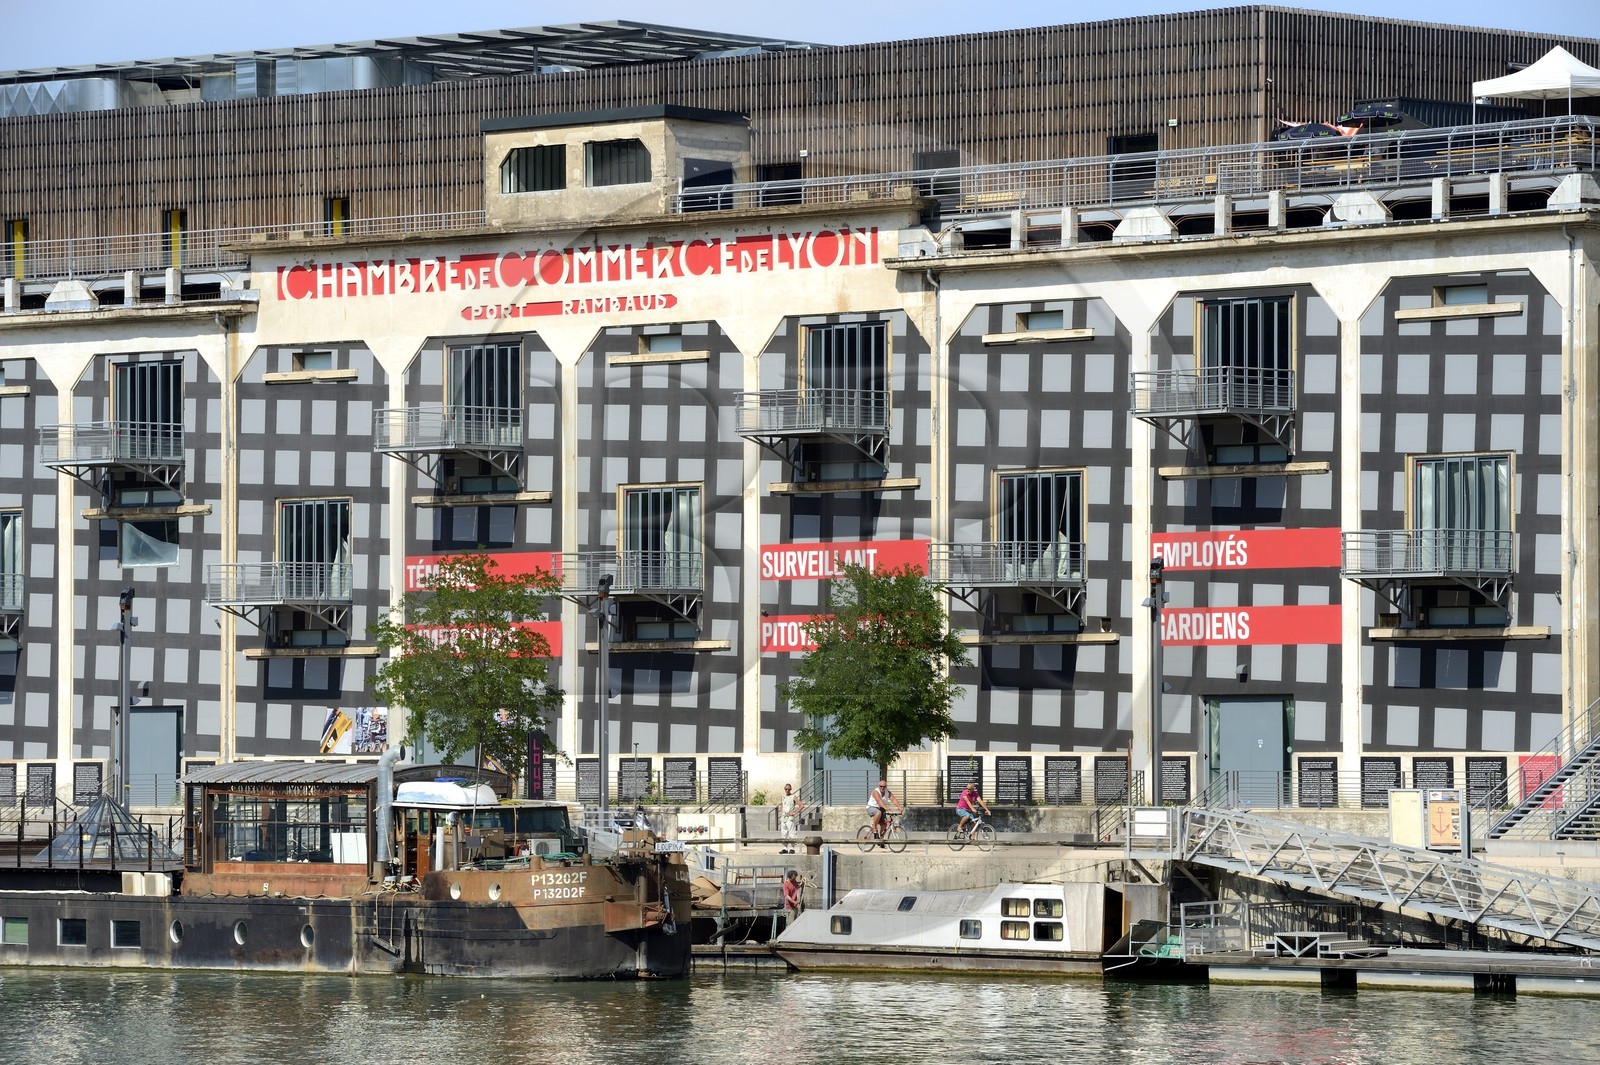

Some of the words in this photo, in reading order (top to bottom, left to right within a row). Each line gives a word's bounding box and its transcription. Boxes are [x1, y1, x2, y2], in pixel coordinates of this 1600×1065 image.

[281, 258, 462, 300] CHAMBRE
[464, 267, 491, 290] DE
[494, 239, 738, 288] COMMERCE
[740, 249, 769, 273] DE
[772, 228, 873, 269] LYON
[471, 302, 528, 321] PORT
[561, 293, 667, 315] RAMBAUD
[762, 549, 877, 578] SURVEILLANT
[531, 872, 588, 886] P13202F
[533, 887, 586, 900] P13202F
